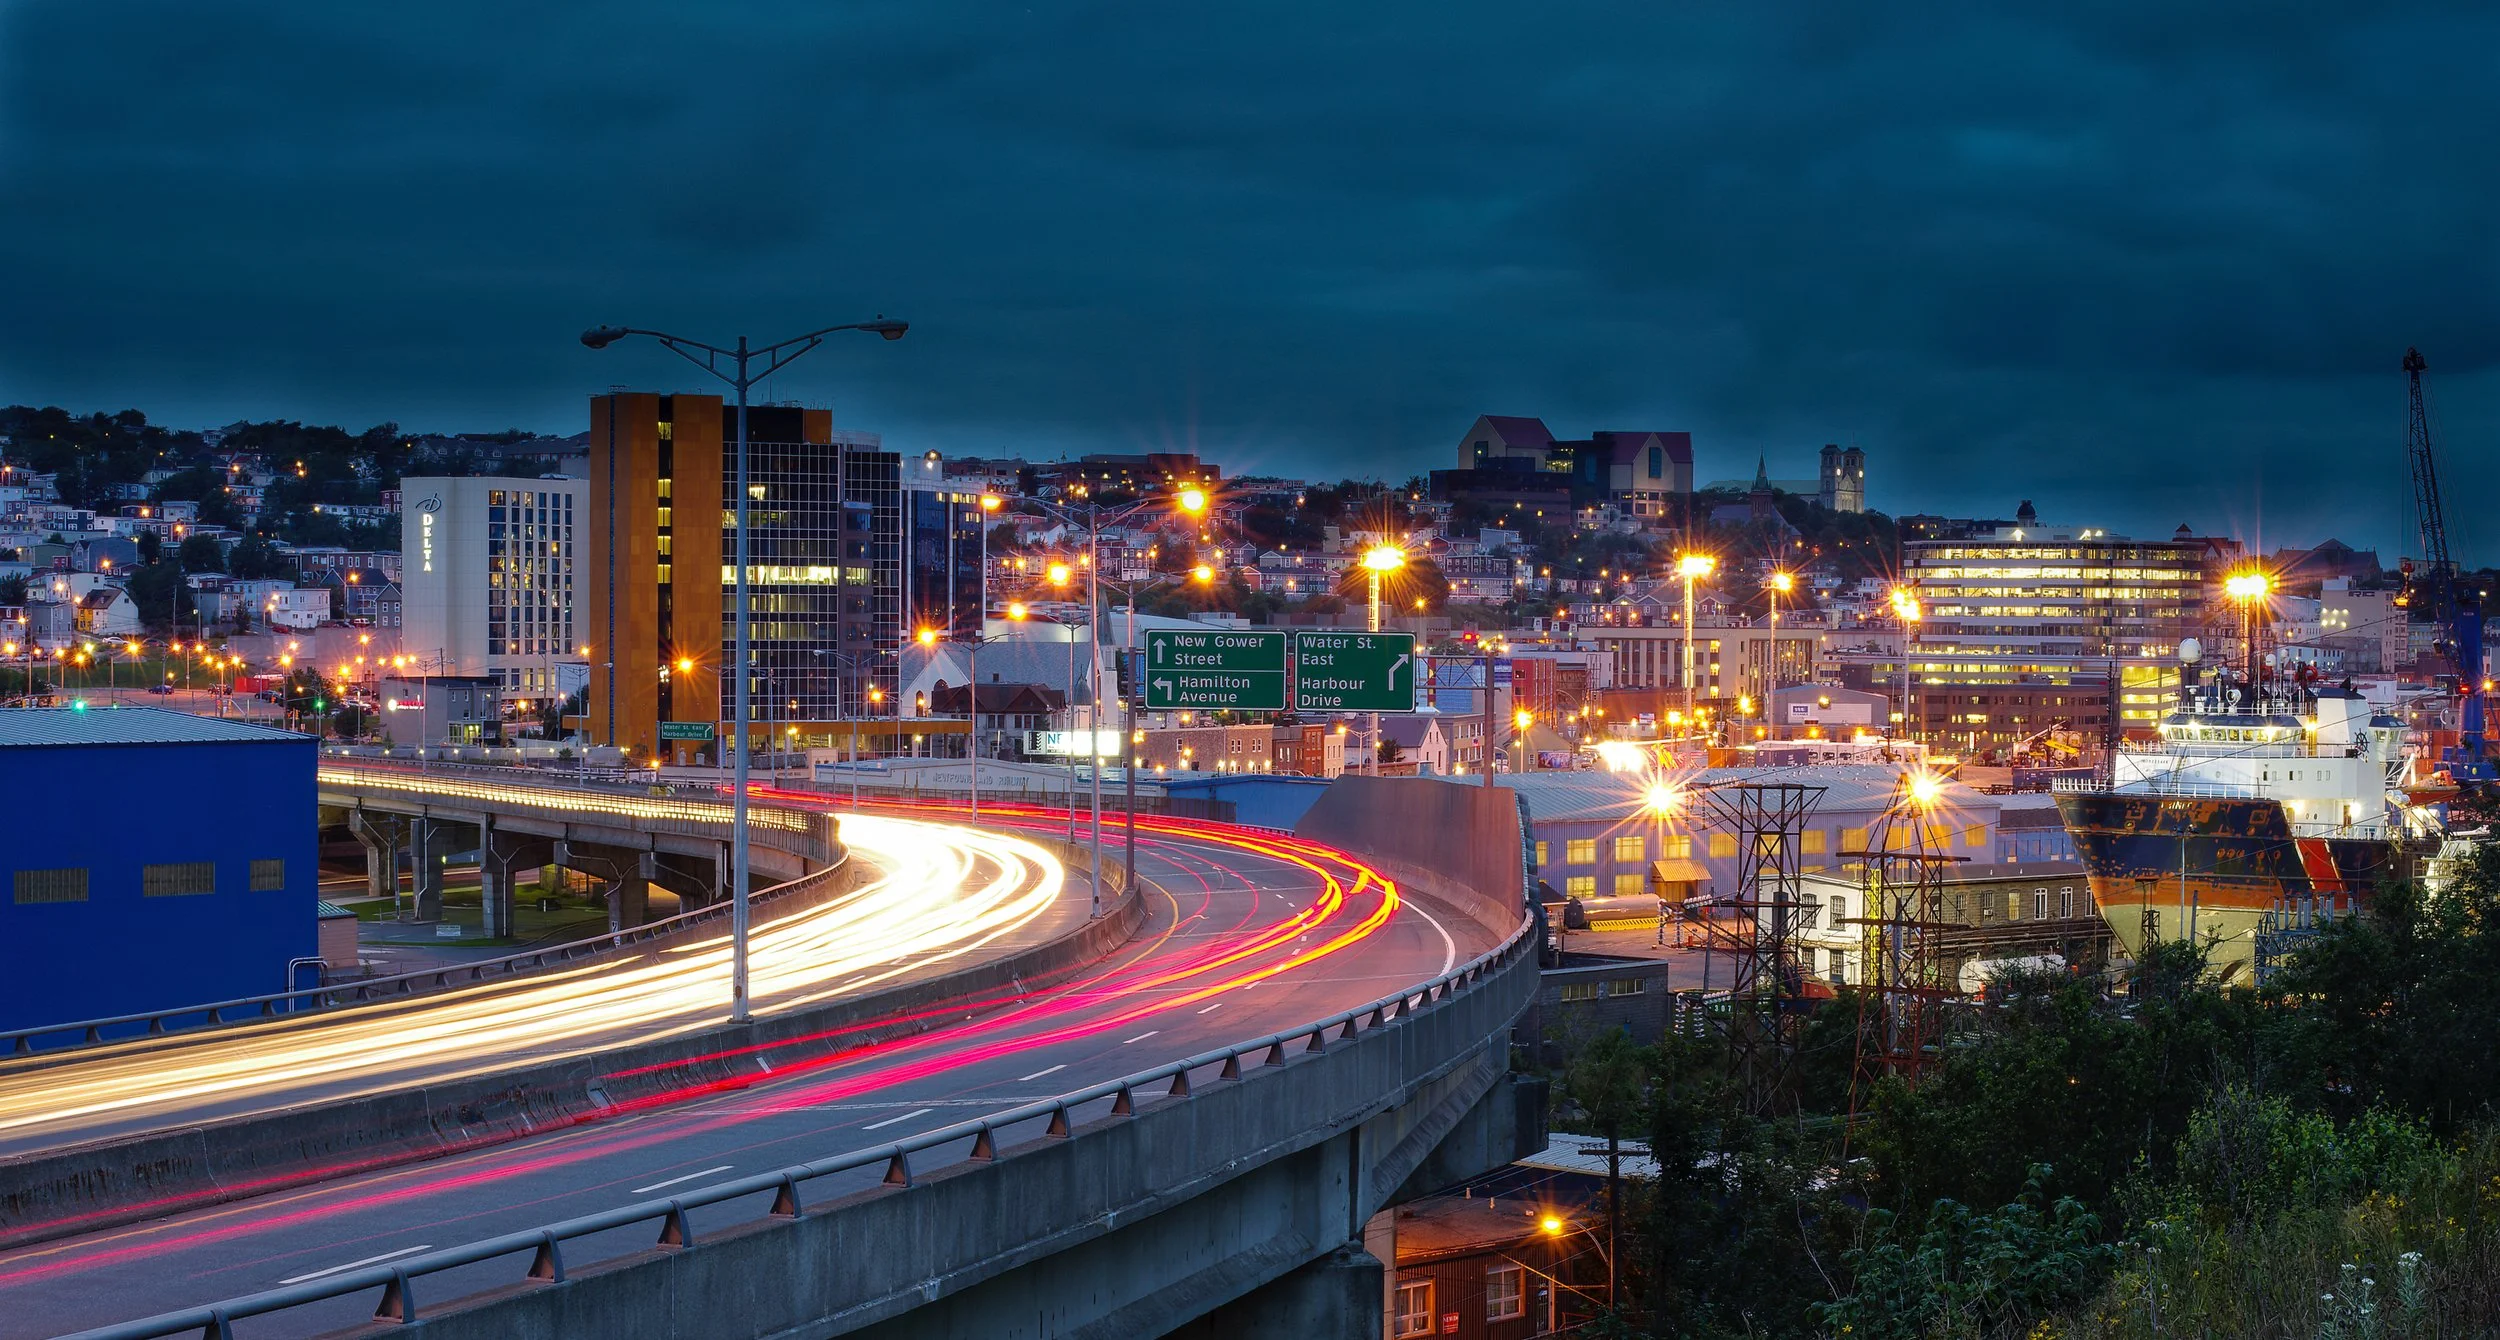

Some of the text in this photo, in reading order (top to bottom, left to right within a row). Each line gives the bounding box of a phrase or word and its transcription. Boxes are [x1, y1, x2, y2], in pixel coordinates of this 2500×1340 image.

[422, 513, 433, 572] DELTA
[1174, 635, 1264, 648] New Gower
[1302, 636, 1376, 649] Water St.
[1175, 653, 1222, 665] Street
[1302, 653, 1334, 666] East
[1179, 675, 1250, 688] Hamilton
[1301, 677, 1365, 690] Harbour
[1179, 691, 1237, 703] Avenue
[1301, 694, 1342, 707] Drive
